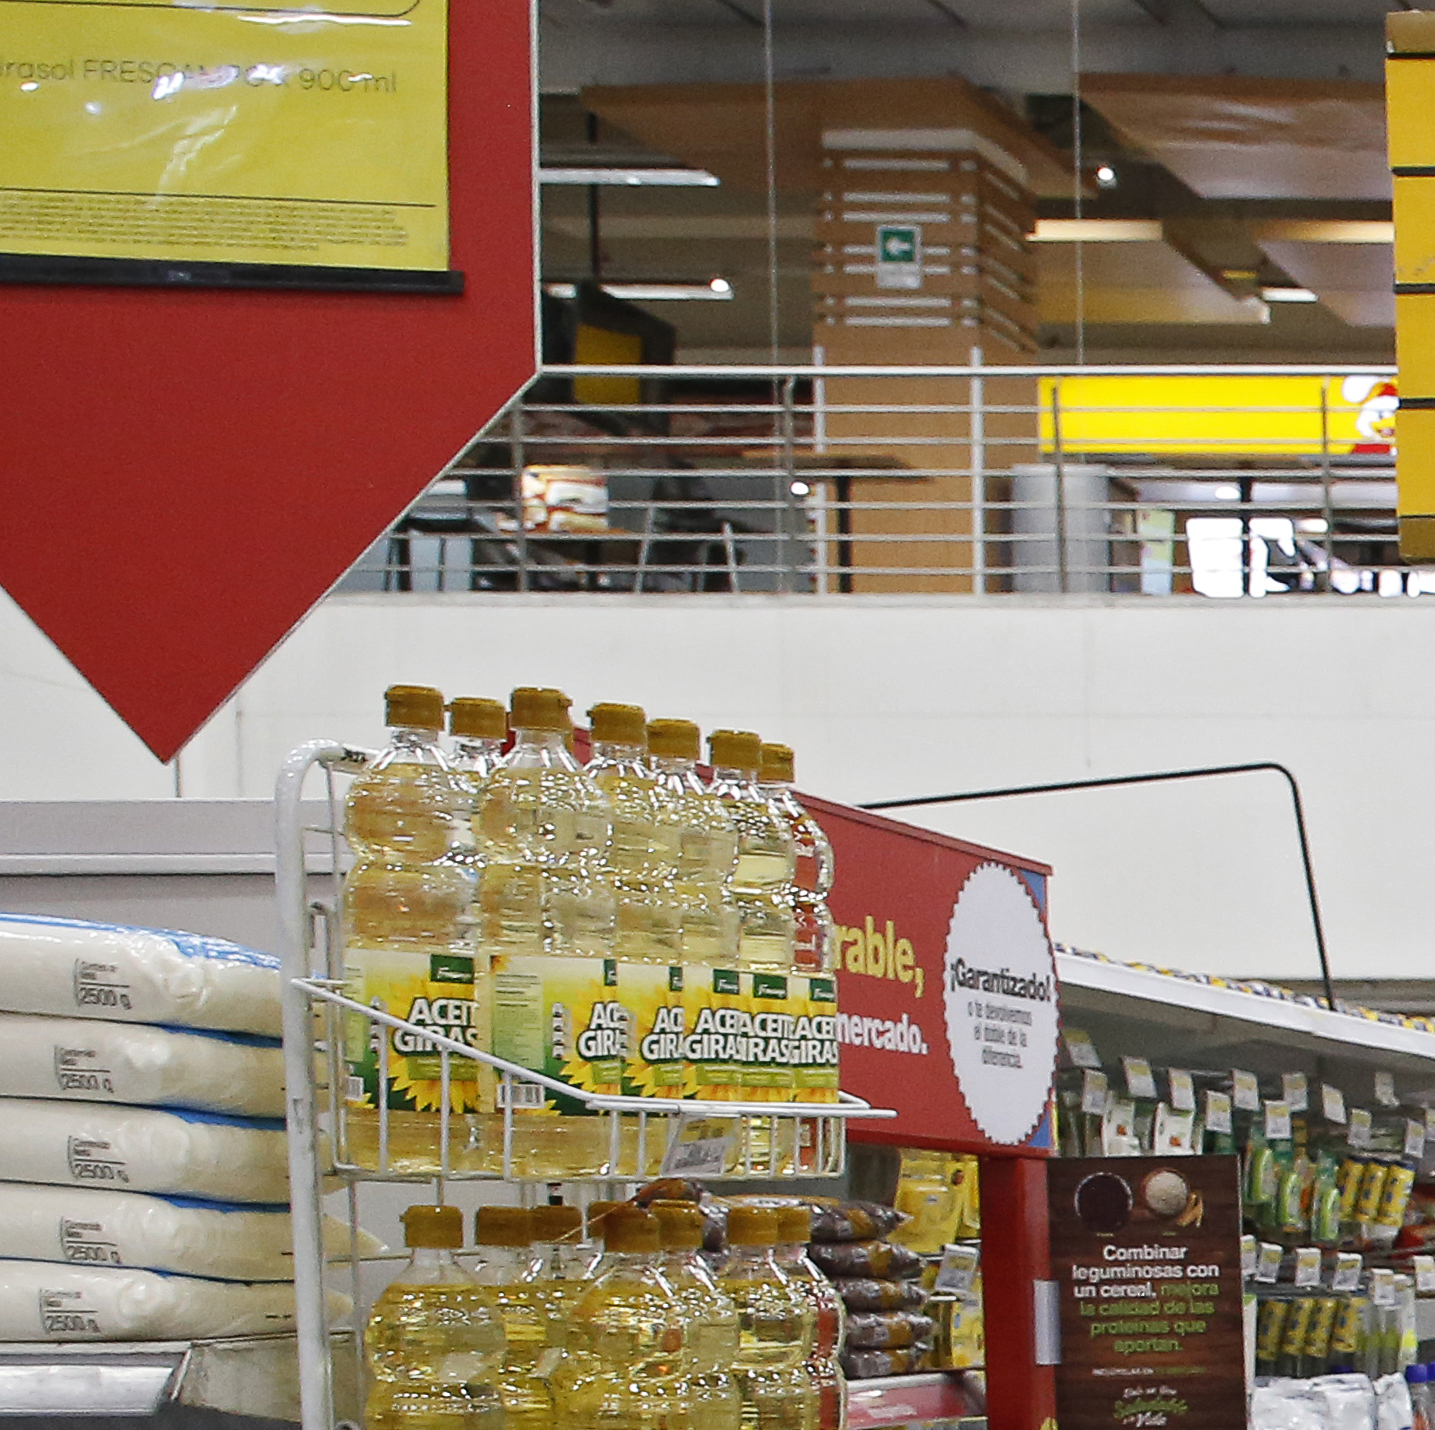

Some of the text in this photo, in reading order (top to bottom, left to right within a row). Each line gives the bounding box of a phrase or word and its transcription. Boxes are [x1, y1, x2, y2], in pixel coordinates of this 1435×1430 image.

[1103, 1244, 1188, 1261] Combinar
[1072, 1264, 1220, 1283] leguminosas con
[1074, 1284, 1097, 1298] un
